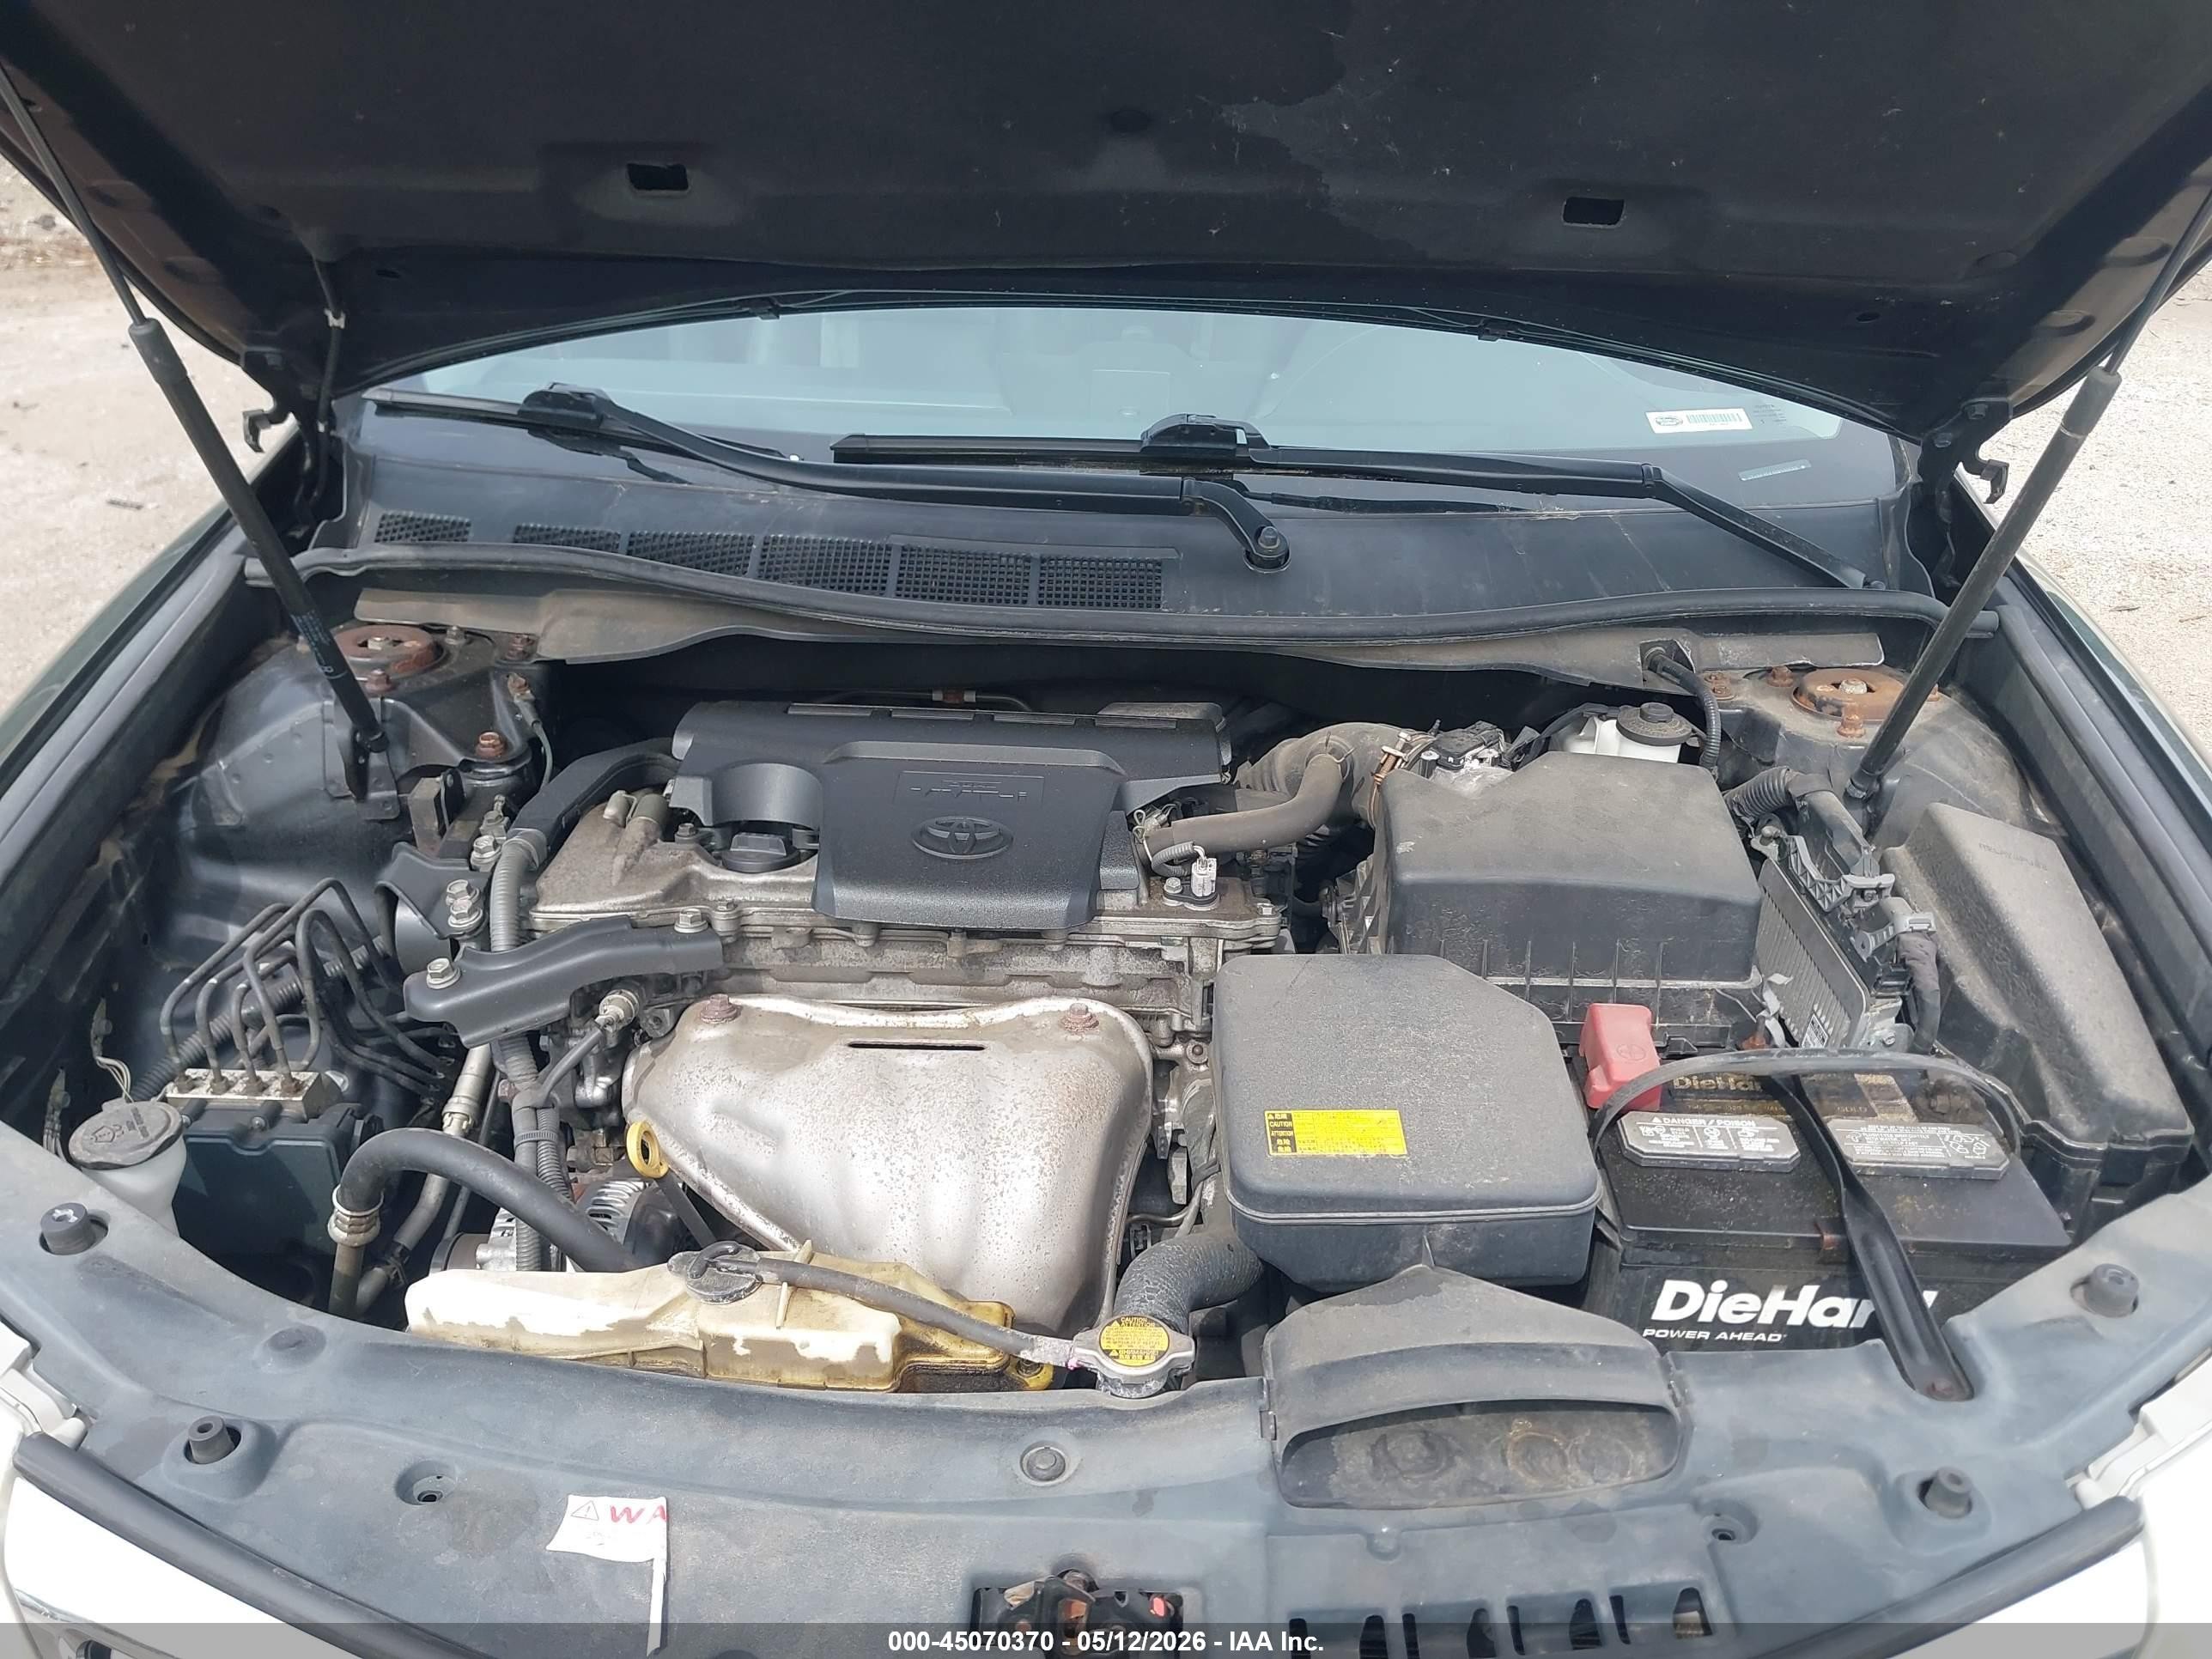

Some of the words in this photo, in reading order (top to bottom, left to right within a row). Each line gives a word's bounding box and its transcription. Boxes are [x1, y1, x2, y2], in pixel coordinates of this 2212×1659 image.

[1673, 1075, 1763, 1092] DieHa
[1662, 1117, 1706, 1126] DANGER
[1642, 1328, 1710, 1340] POWER
[1714, 1331, 1784, 1342] AHEAD
